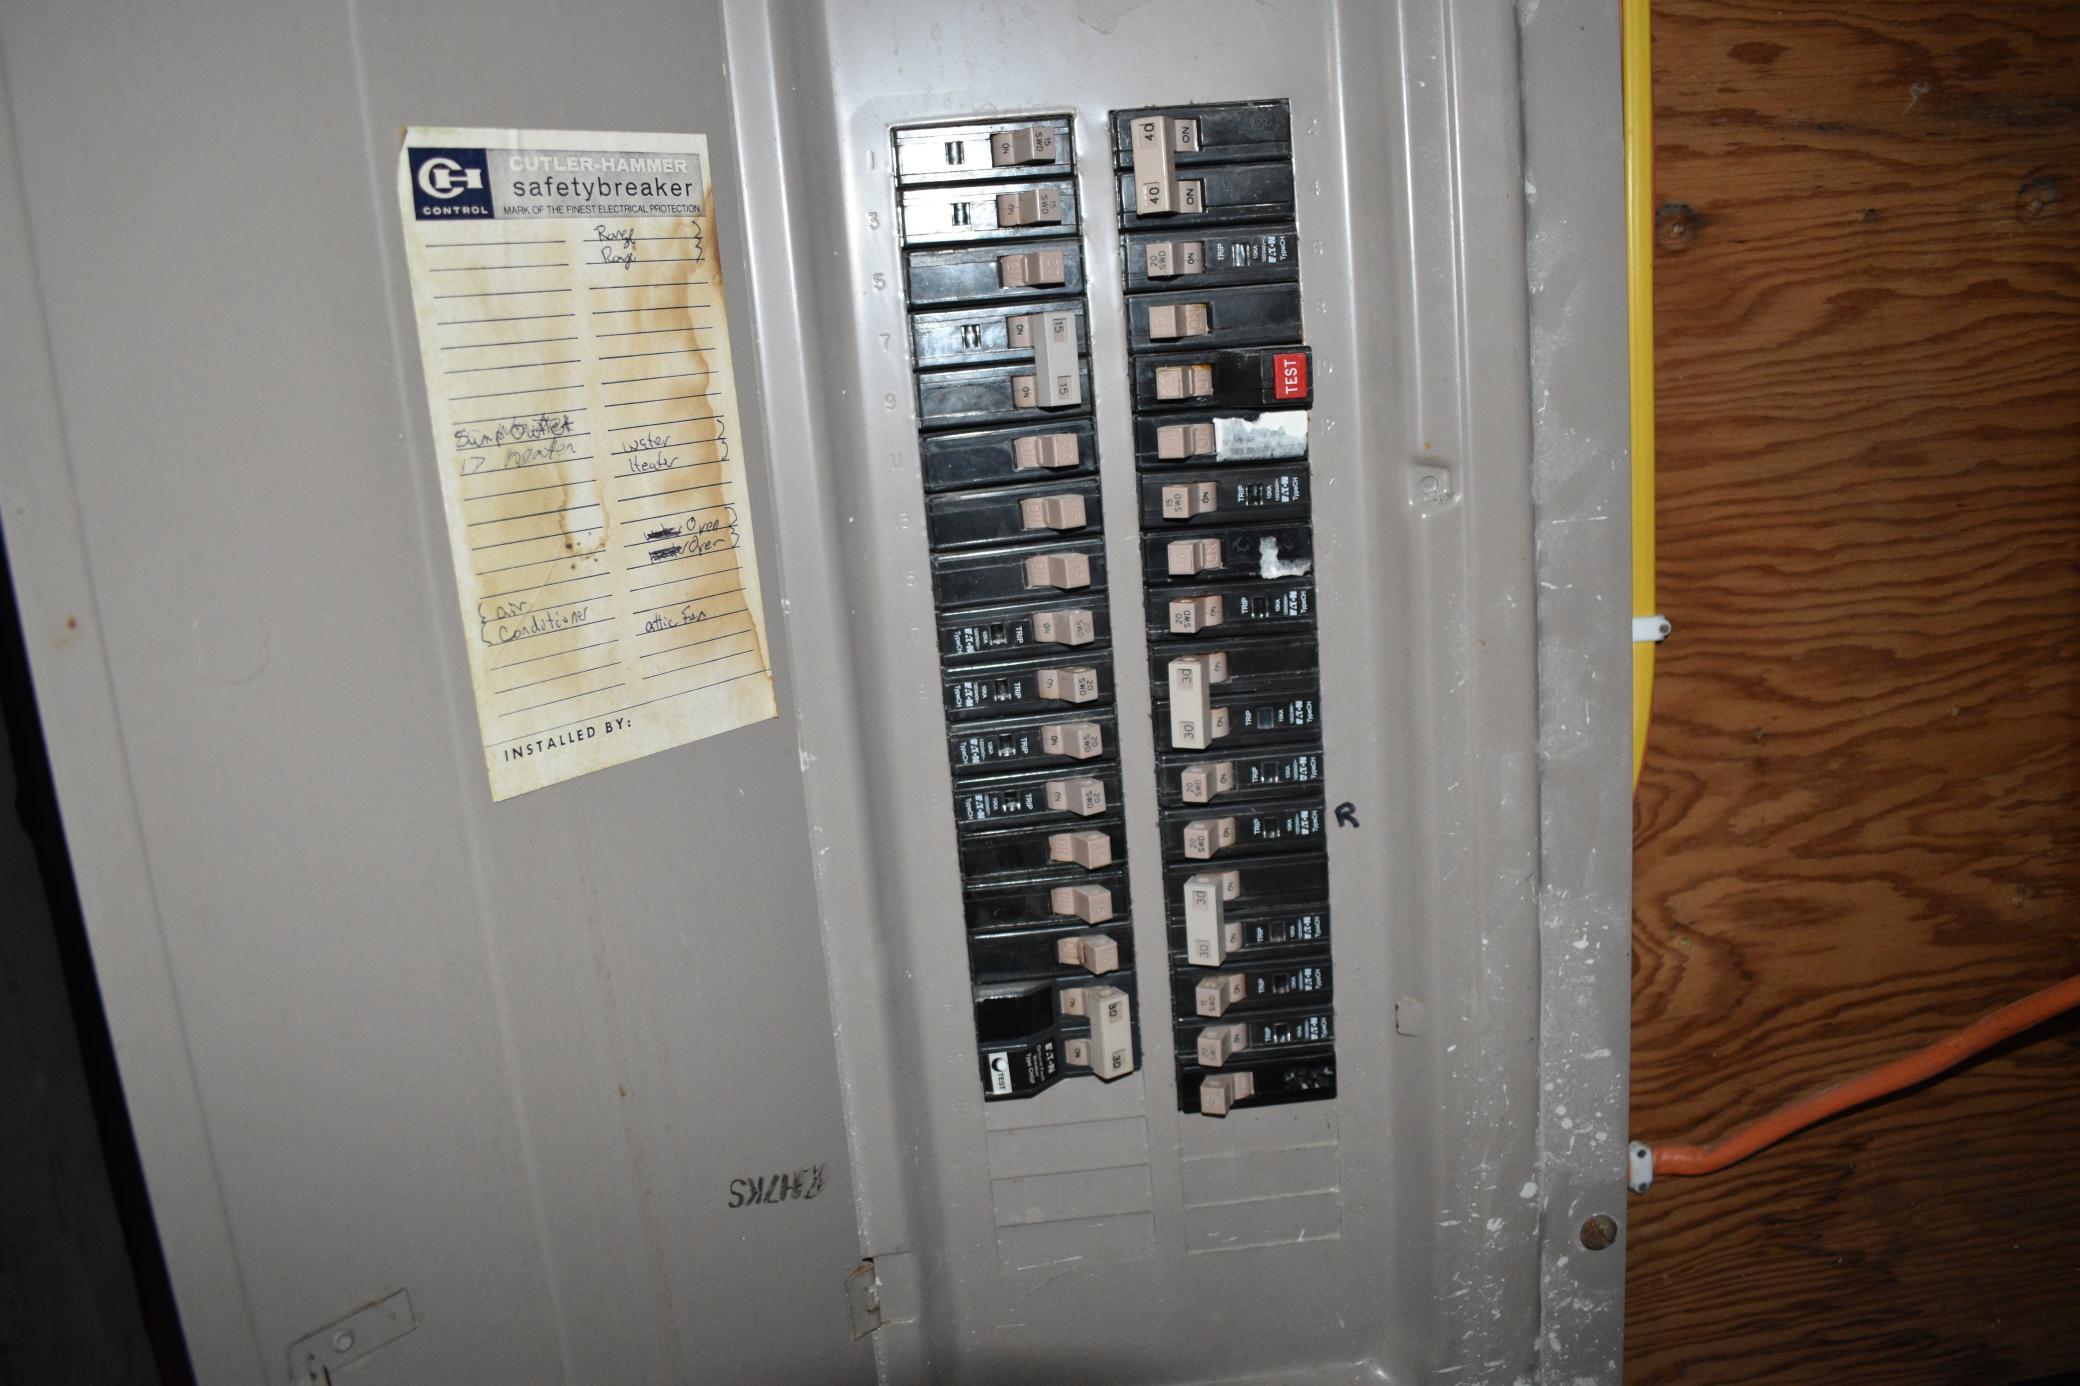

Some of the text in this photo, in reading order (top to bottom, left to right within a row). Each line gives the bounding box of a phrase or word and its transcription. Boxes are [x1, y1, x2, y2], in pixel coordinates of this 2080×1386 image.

[1144, 124, 1155, 141] 40
[1182, 126, 1190, 143] ON
[1002, 142, 1009, 154] ON
[509, 155, 687, 173] CUTLER-HAMMER
[513, 176, 693, 201] safetybreaker
[1149, 187, 1160, 204] 40
[1186, 188, 1194, 205] ON
[423, 205, 488, 216] CONTROL
[504, 204, 700, 215] MARK OF THE FINEST ELECTRICAL PROTECTION
[1008, 204, 1015, 215] ON
[1188, 252, 1194, 265] ON
[1217, 242, 1225, 261] TRIP
[1016, 324, 1024, 336] ON
[1053, 320, 1064, 334] 15
[1284, 359, 1298, 394] TEST
[1022, 386, 1030, 398] ON
[1059, 385, 1069, 396] 15
[1202, 492, 1209, 503] ON
[1015, 625, 1024, 644] TRIP
[1043, 623, 1051, 634] ON
[1183, 669, 1192, 683] 30
[1014, 681, 1022, 699] TRIP
[1046, 678, 1053, 689] ON
[1078, 677, 1086, 696] SWD
[1184, 725, 1195, 739] 30
[504, 718, 632, 761] INSTALLED BY:
[1020, 736, 1029, 754] TRIP
[1050, 735, 1058, 746] ON
[1220, 773, 1227, 783] ON
[1024, 792, 1034, 810] TRIP
[1085, 790, 1094, 809] SWD
[1334, 802, 1360, 829] R
[1223, 827, 1229, 837] ON
[1197, 891, 1207, 905] 30
[1200, 944, 1208, 958] 30
[1108, 1004, 1118, 1017] 30
[1074, 1048, 1081, 1058] ON
[1112, 1055, 1122, 1069] 30
[998, 1073, 1006, 1090] TEST
